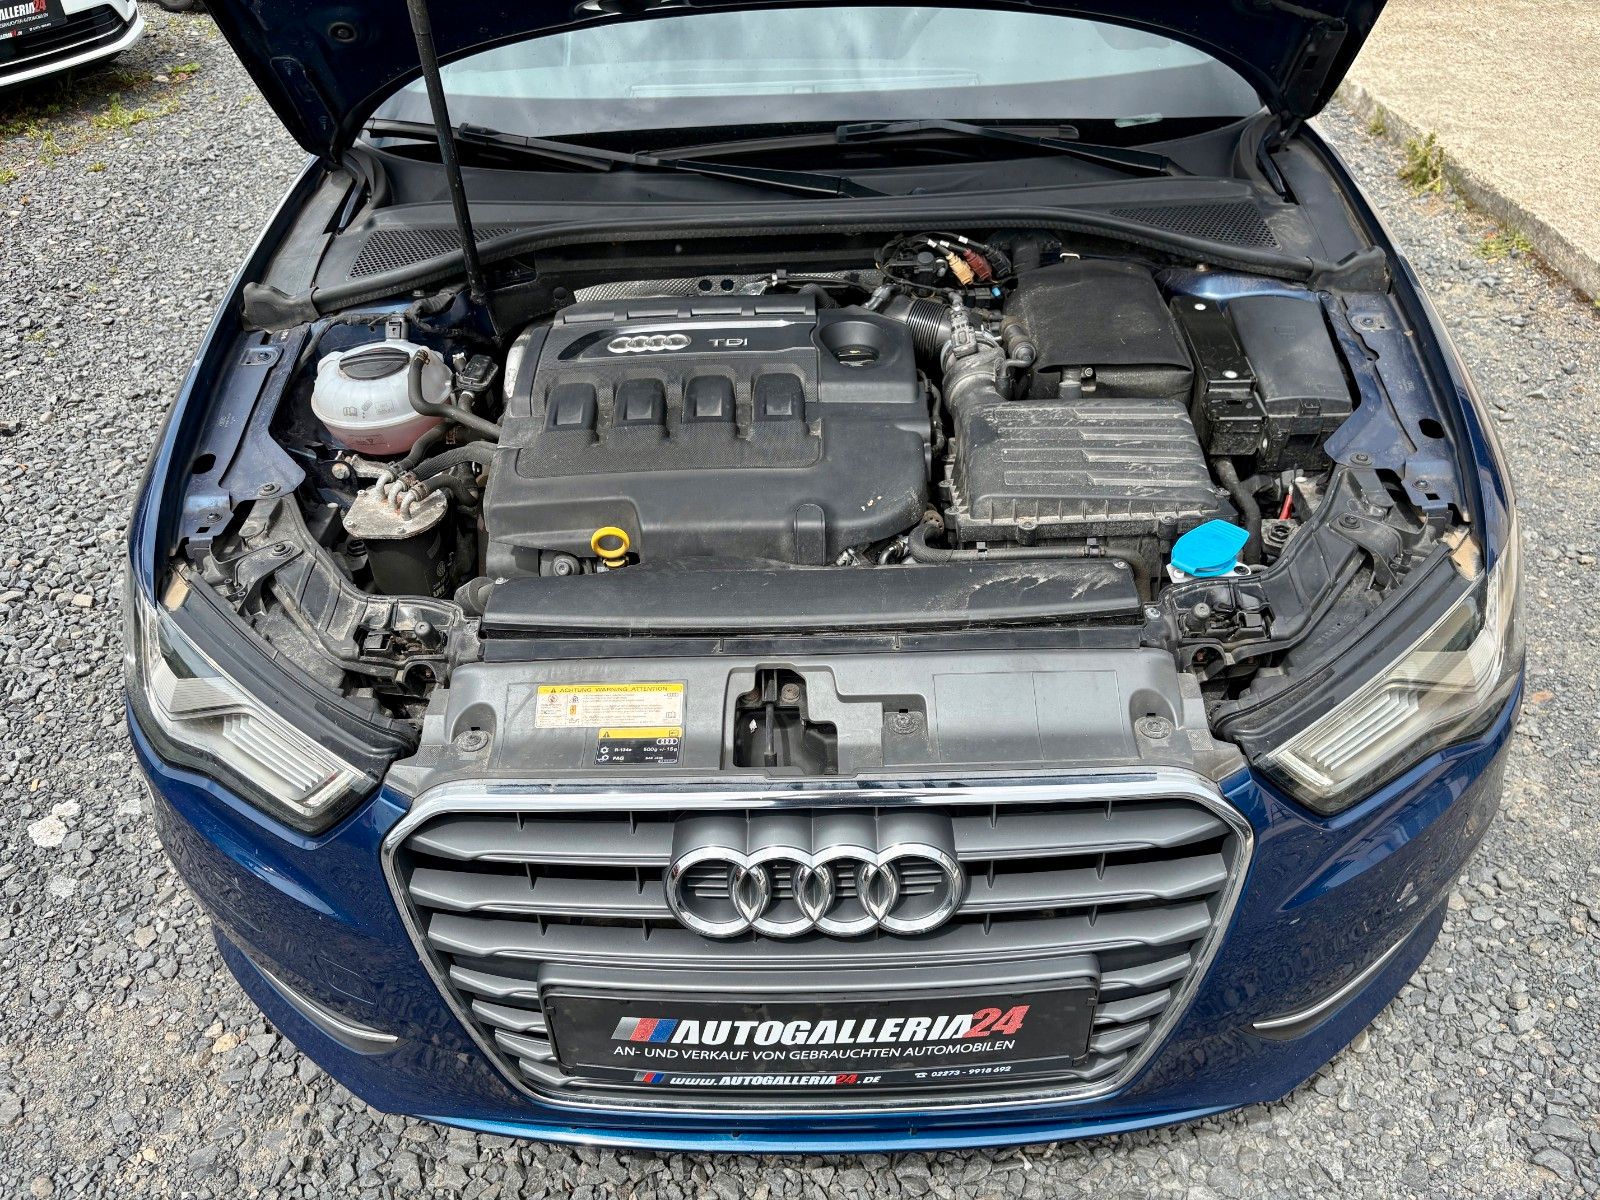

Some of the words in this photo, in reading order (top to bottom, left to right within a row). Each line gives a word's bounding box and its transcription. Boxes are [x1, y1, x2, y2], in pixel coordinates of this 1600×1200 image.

[708, 338, 748, 347] TDI
[670, 1005, 1031, 1046] AUTOGALLERIA24
[613, 1046, 641, 1057] AN-
[644, 1048, 679, 1059] UND
[681, 1049, 749, 1061] VERKAUF
[752, 1051, 786, 1061] VON
[789, 1048, 901, 1061] GEBRAUCHTEN
[903, 1040, 1016, 1057] AUTOMOBILEN
[931, 1069, 960, 1078] 02273
[968, 1067, 991, 1076] 9918
[993, 1065, 1012, 1074] 692
